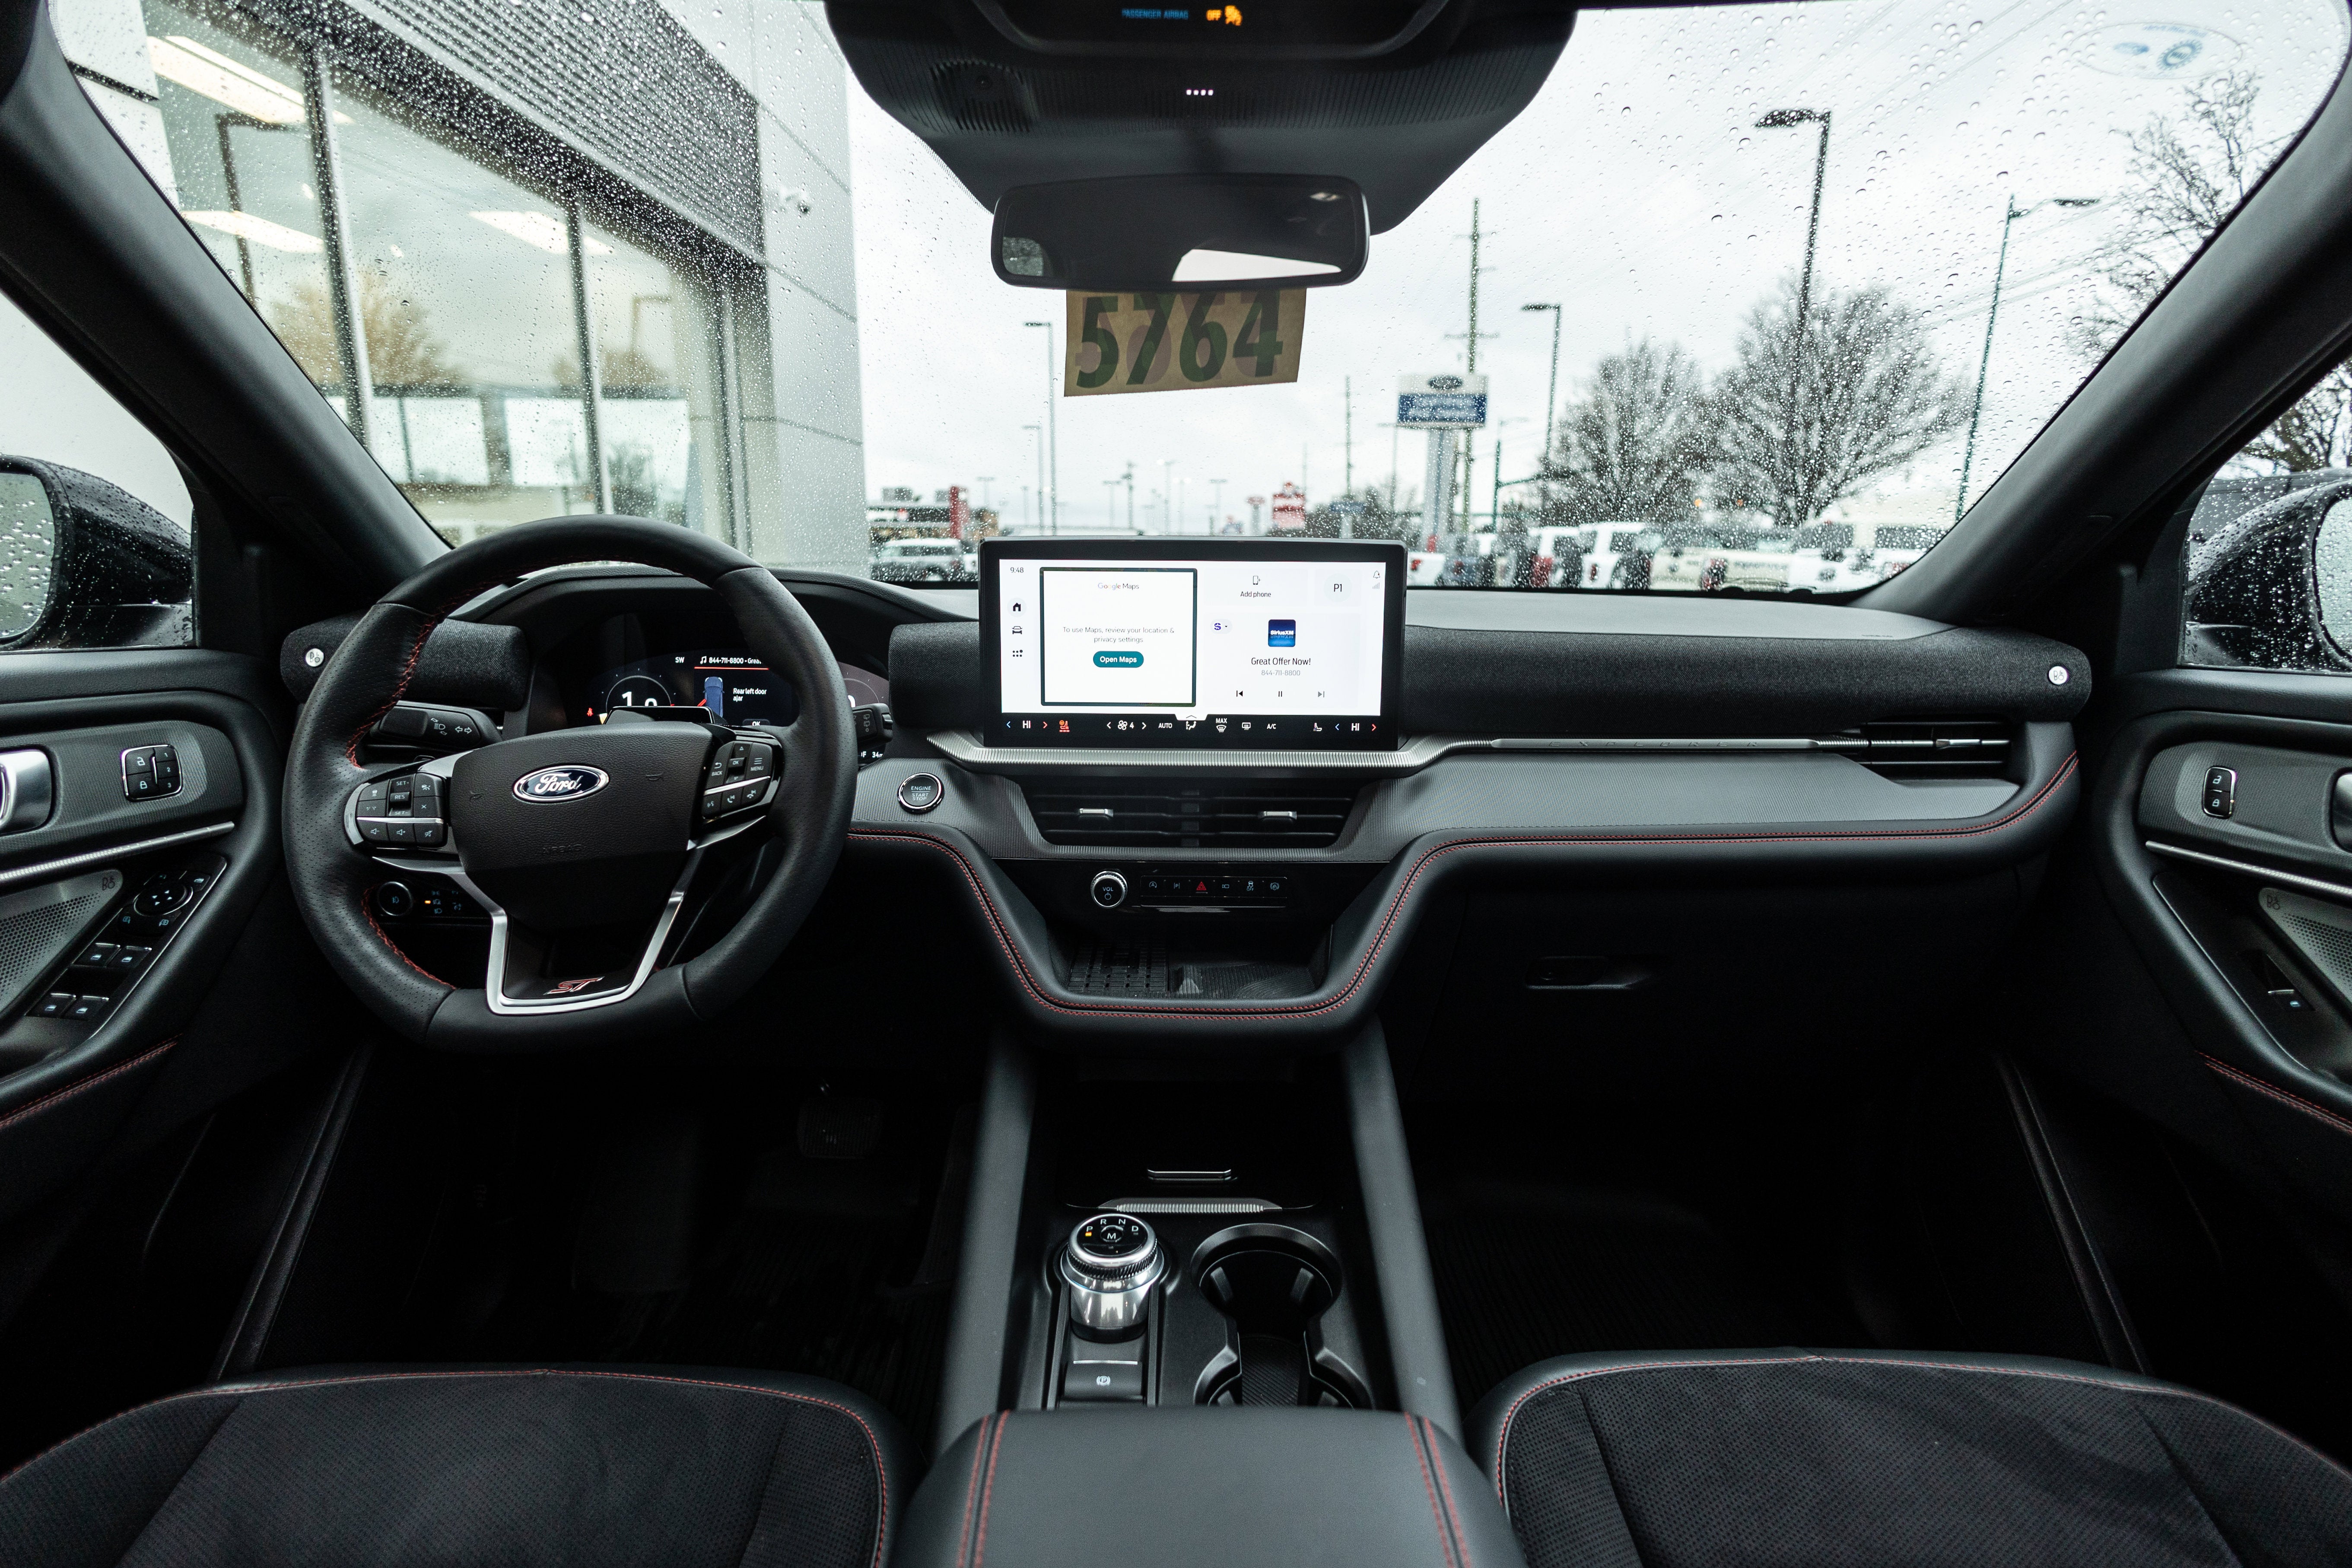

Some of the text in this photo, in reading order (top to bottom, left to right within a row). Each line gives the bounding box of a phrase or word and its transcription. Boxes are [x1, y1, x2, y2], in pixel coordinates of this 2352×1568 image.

[1122, 9, 1188, 19] PASSENGER AIRBAG
[1206, 10, 1222, 21] OFF
[1076, 289, 1284, 388] 5764
[1097, 582, 1121, 591] Google
[1333, 583, 1342, 592] P1
[1100, 656, 1118, 664] Open
[1251, 657, 1271, 665] Great
[1273, 657, 1291, 665] Offer
[1022, 720, 1031, 729] HI
[1351, 722, 1360, 731] HI
[534, 772, 584, 794] Ford
[543, 976, 605, 996] ST
